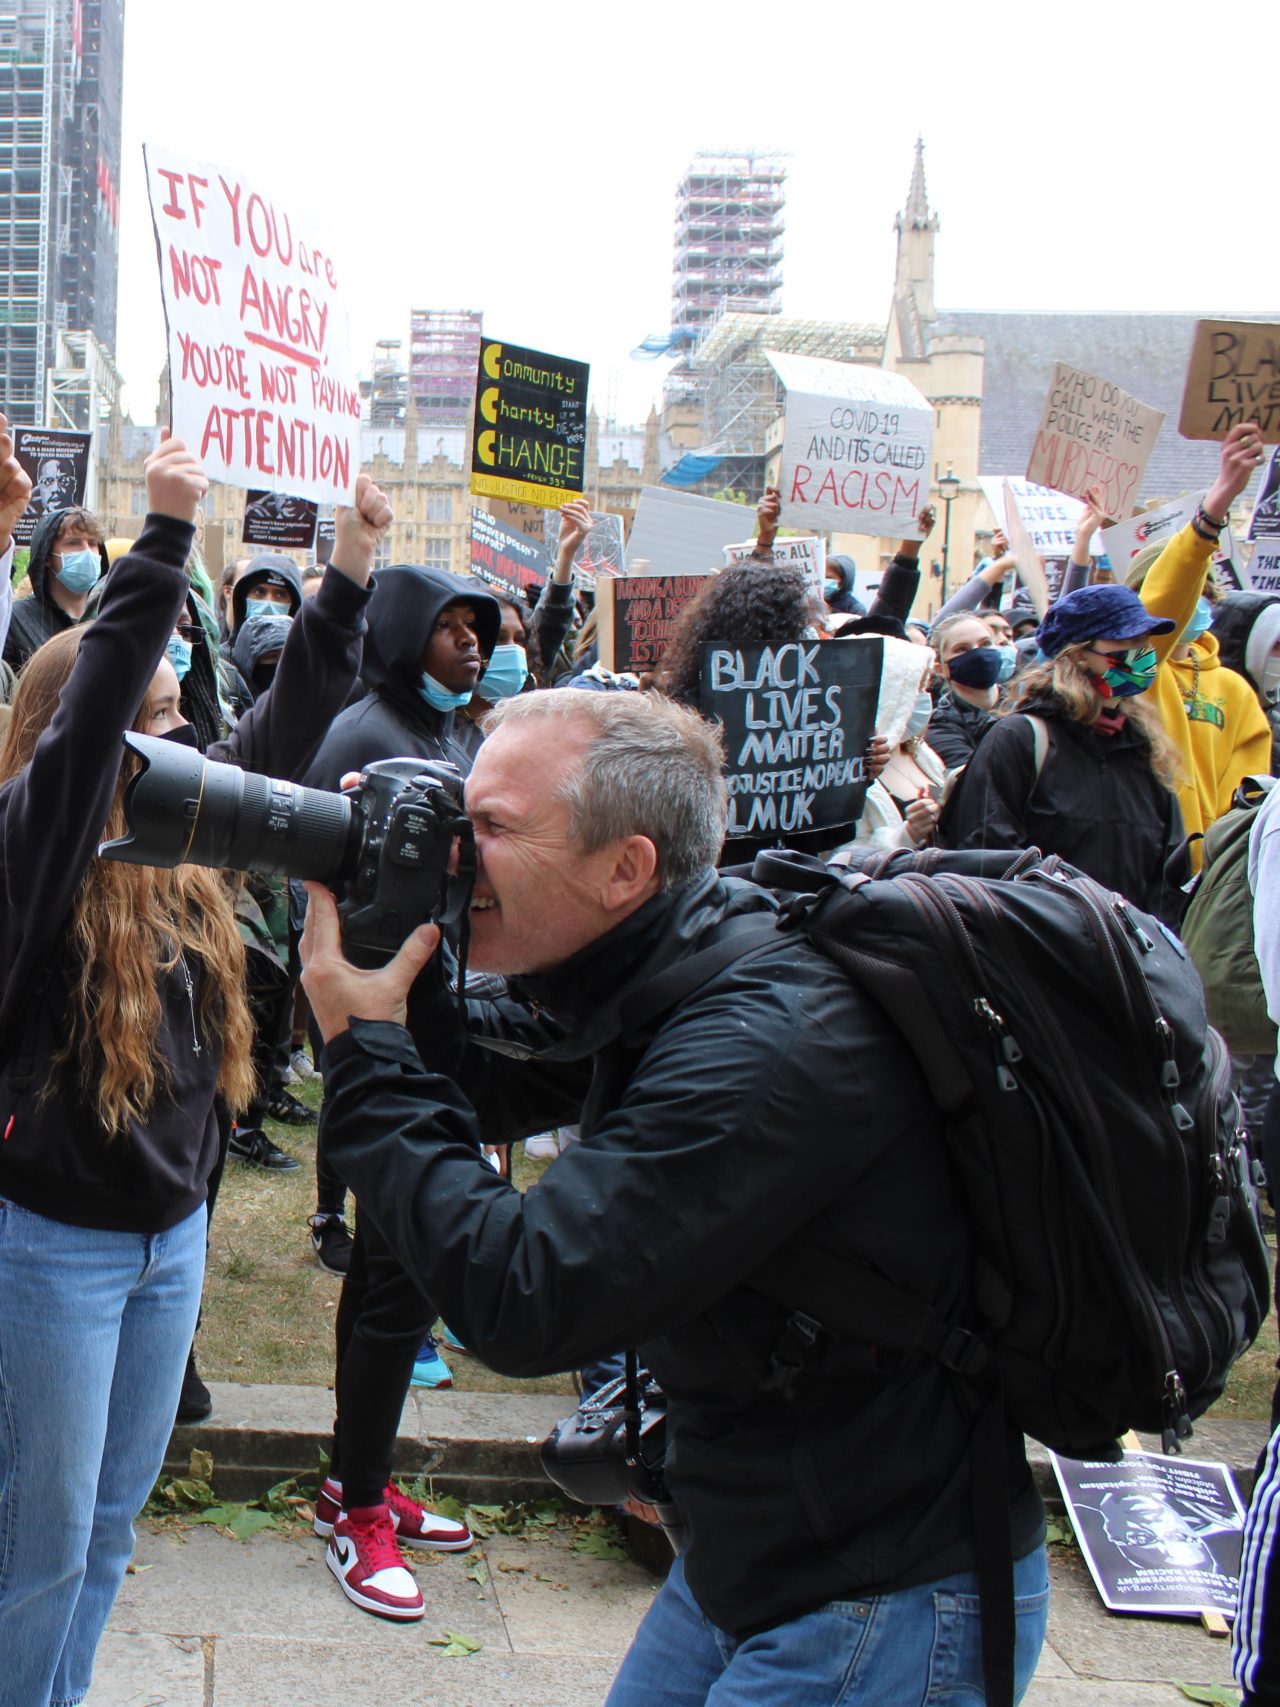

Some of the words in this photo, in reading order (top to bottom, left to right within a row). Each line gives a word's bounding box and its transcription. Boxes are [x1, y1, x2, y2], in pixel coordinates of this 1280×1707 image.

[157, 168, 209, 229] IF
[219, 174, 293, 267] YOU
[298, 239, 338, 290] are
[169, 244, 222, 306] NOT
[483, 343, 575, 393] Community
[1210, 332, 1280, 381] BLA
[177, 331, 251, 400] YOU'RE
[260, 361, 297, 405] NOT
[311, 367, 361, 419] PAYING
[1056, 366, 1096, 399] WHO
[1100, 383, 1118, 407] DO
[480, 387, 555, 429] Charity
[830, 407, 899, 436] COVID-19
[1050, 390, 1085, 417] CALL
[1092, 404, 1120, 433] WHEN
[1123, 419, 1144, 444] THE
[1211, 403, 1280, 432] MAT
[200, 404, 350, 489] ATTENTION
[1046, 411, 1093, 443] POLICE
[1094, 429, 1114, 453] ARE
[477, 429, 580, 479] CHANGE
[807, 434, 845, 461] AND
[873, 442, 925, 471] CALLED
[475, 479, 487, 490] NO
[491, 481, 526, 497] JUSTICE
[532, 488, 546, 502] NO
[790, 464, 920, 518] RACISM
[477, 510, 496, 526] SAID
[1022, 506, 1067, 520] IVES
[790, 543, 810, 559] ALL
[1029, 531, 1076, 545] ATTE
[615, 577, 662, 600] TURNING
[662, 577, 673, 597] A
[624, 599, 651, 621] AND
[651, 598, 662, 619] A
[627, 620, 648, 641] TO
[629, 641, 651, 662] IS
[711, 642, 820, 691] BLACK
[745, 685, 842, 730] LIVES
[737, 727, 844, 767] MATTER
[726, 773, 741, 796] O
[740, 768, 804, 795] JUSTICE
[802, 763, 826, 791] NO
[826, 756, 867, 788] PEACE
[1145, 1462, 1167, 1472] FOR
[1168, 1466, 1201, 1479] FIGHT
[1174, 1474, 1216, 1488] Malcolm
[1079, 1481, 1138, 1490] capitalism
[1175, 1481, 1220, 1496] without
[1117, 1575, 1187, 1584] MOVEMENT
[1184, 1569, 1227, 1580] SMASH
[1188, 1576, 1222, 1586] MASS
[1116, 1583, 1228, 1596] socialistparty.org.uk
